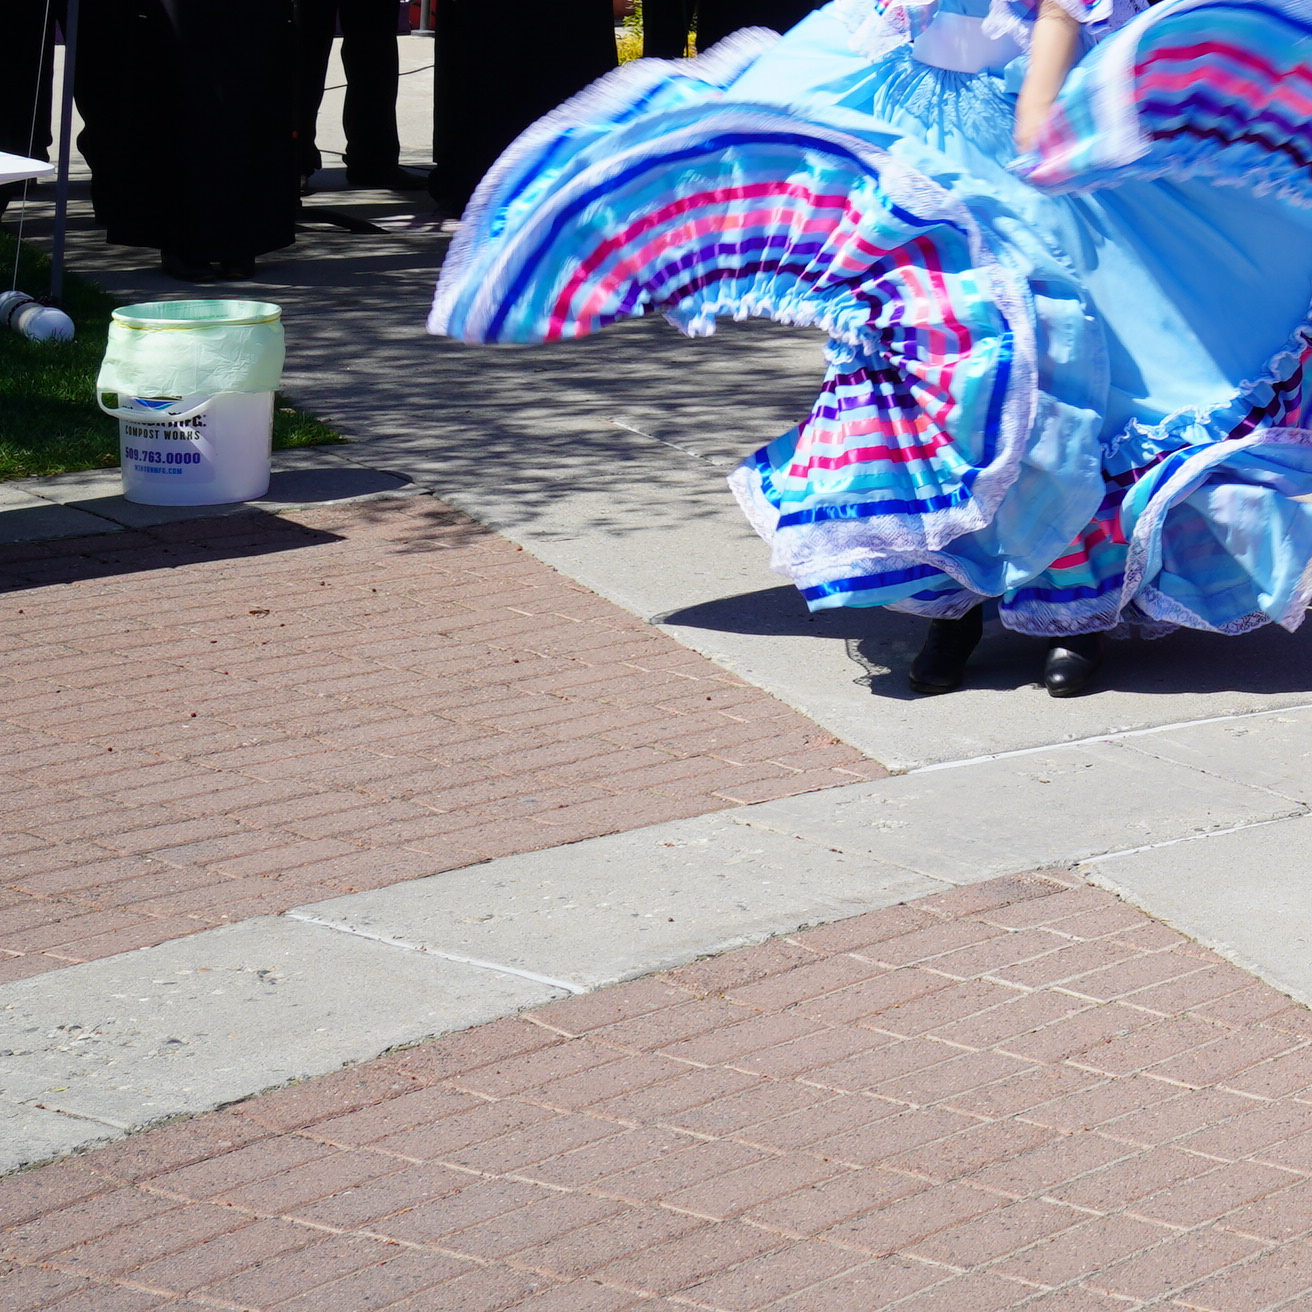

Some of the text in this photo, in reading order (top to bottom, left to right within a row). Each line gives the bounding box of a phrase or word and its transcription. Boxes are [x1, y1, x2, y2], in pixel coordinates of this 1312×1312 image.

[125, 425, 200, 441] COMPOST WORKS
[125, 446, 201, 465] 509.763.0000
